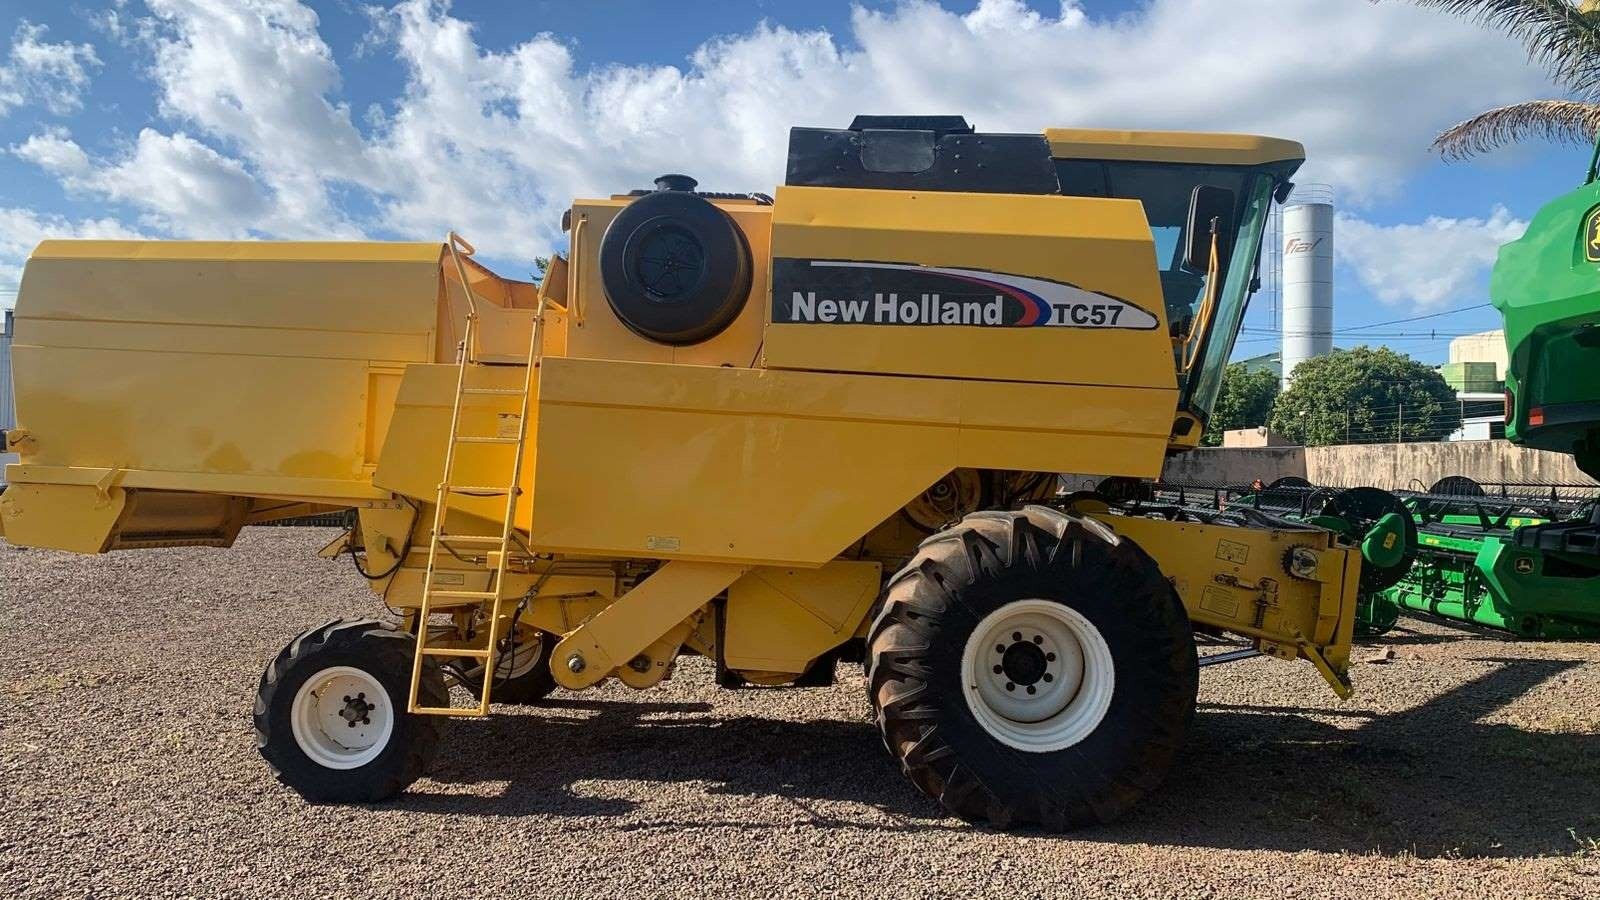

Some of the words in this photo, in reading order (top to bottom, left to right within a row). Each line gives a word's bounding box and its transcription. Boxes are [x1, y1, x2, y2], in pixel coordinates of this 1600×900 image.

[791, 291, 869, 322] New
[874, 293, 1003, 325] Holland
[1052, 303, 1124, 326] TC57
